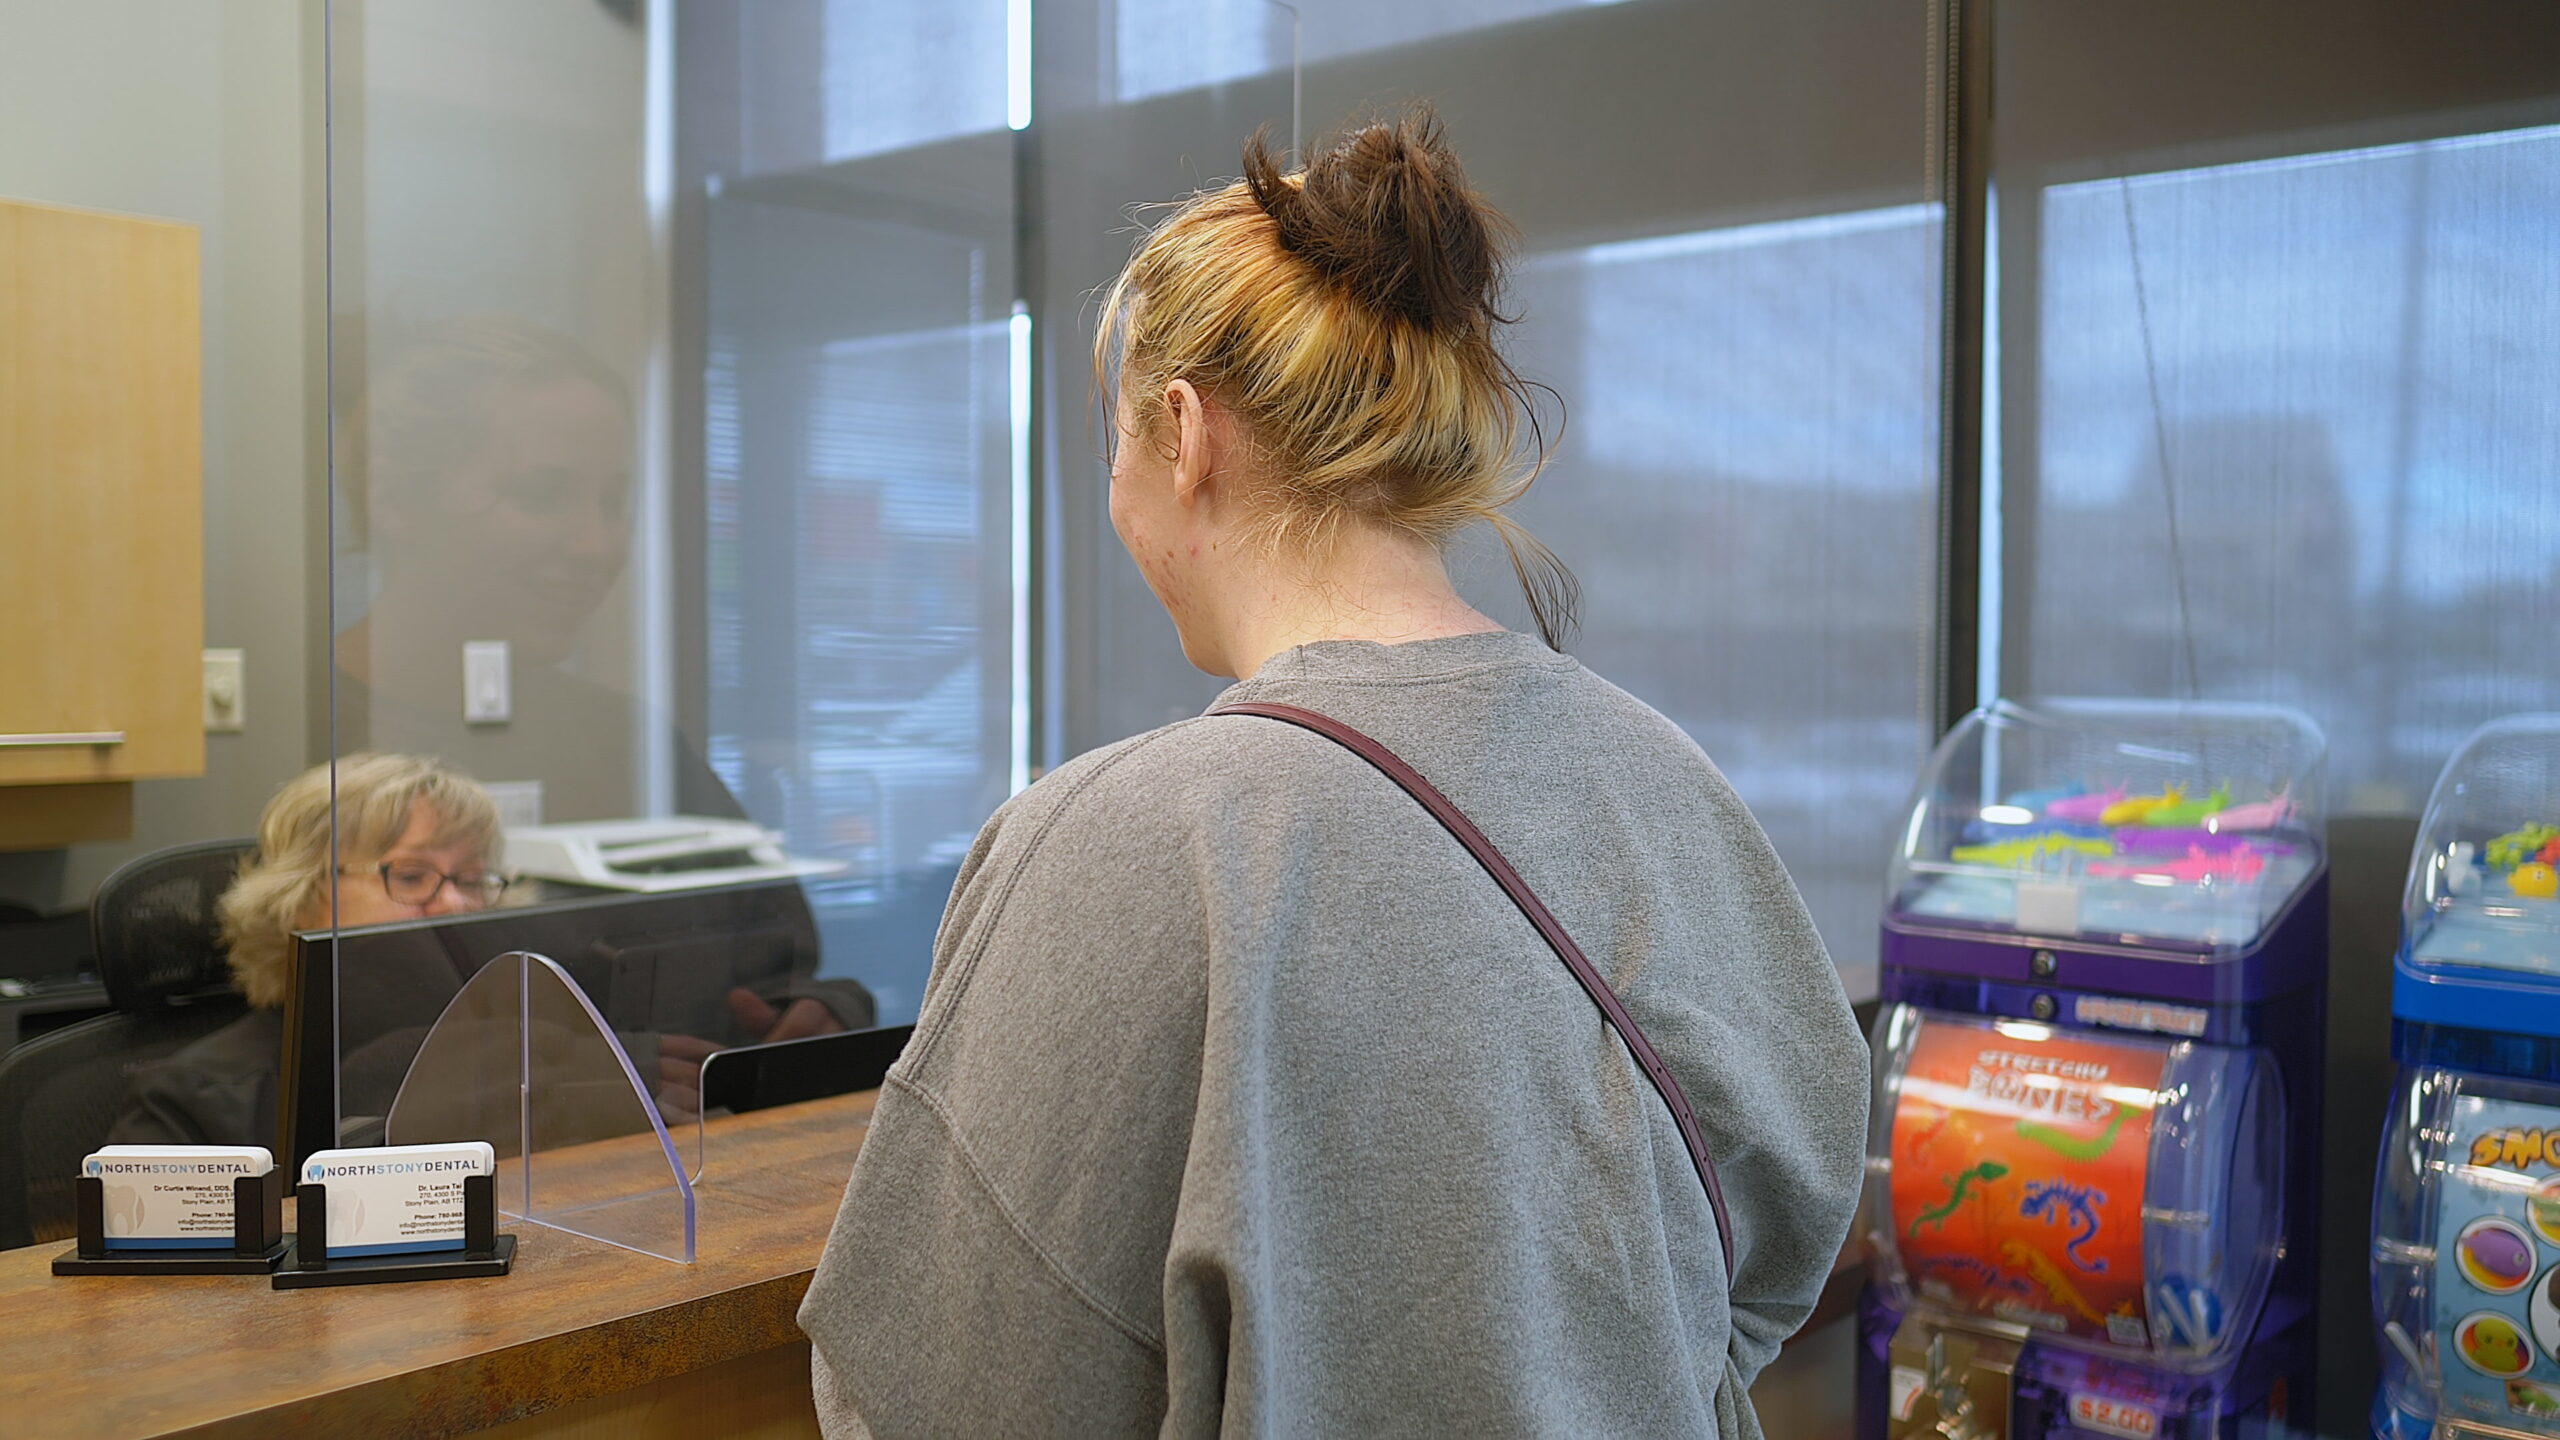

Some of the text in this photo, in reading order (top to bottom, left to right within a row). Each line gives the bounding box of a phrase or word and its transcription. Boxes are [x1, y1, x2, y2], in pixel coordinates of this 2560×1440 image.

[105, 1163, 251, 1174] NORTHSTONYDENTAL
[327, 1159, 479, 1176] NORTHSTONYDENTAL
[2077, 1399, 2155, 1434] $2.00
